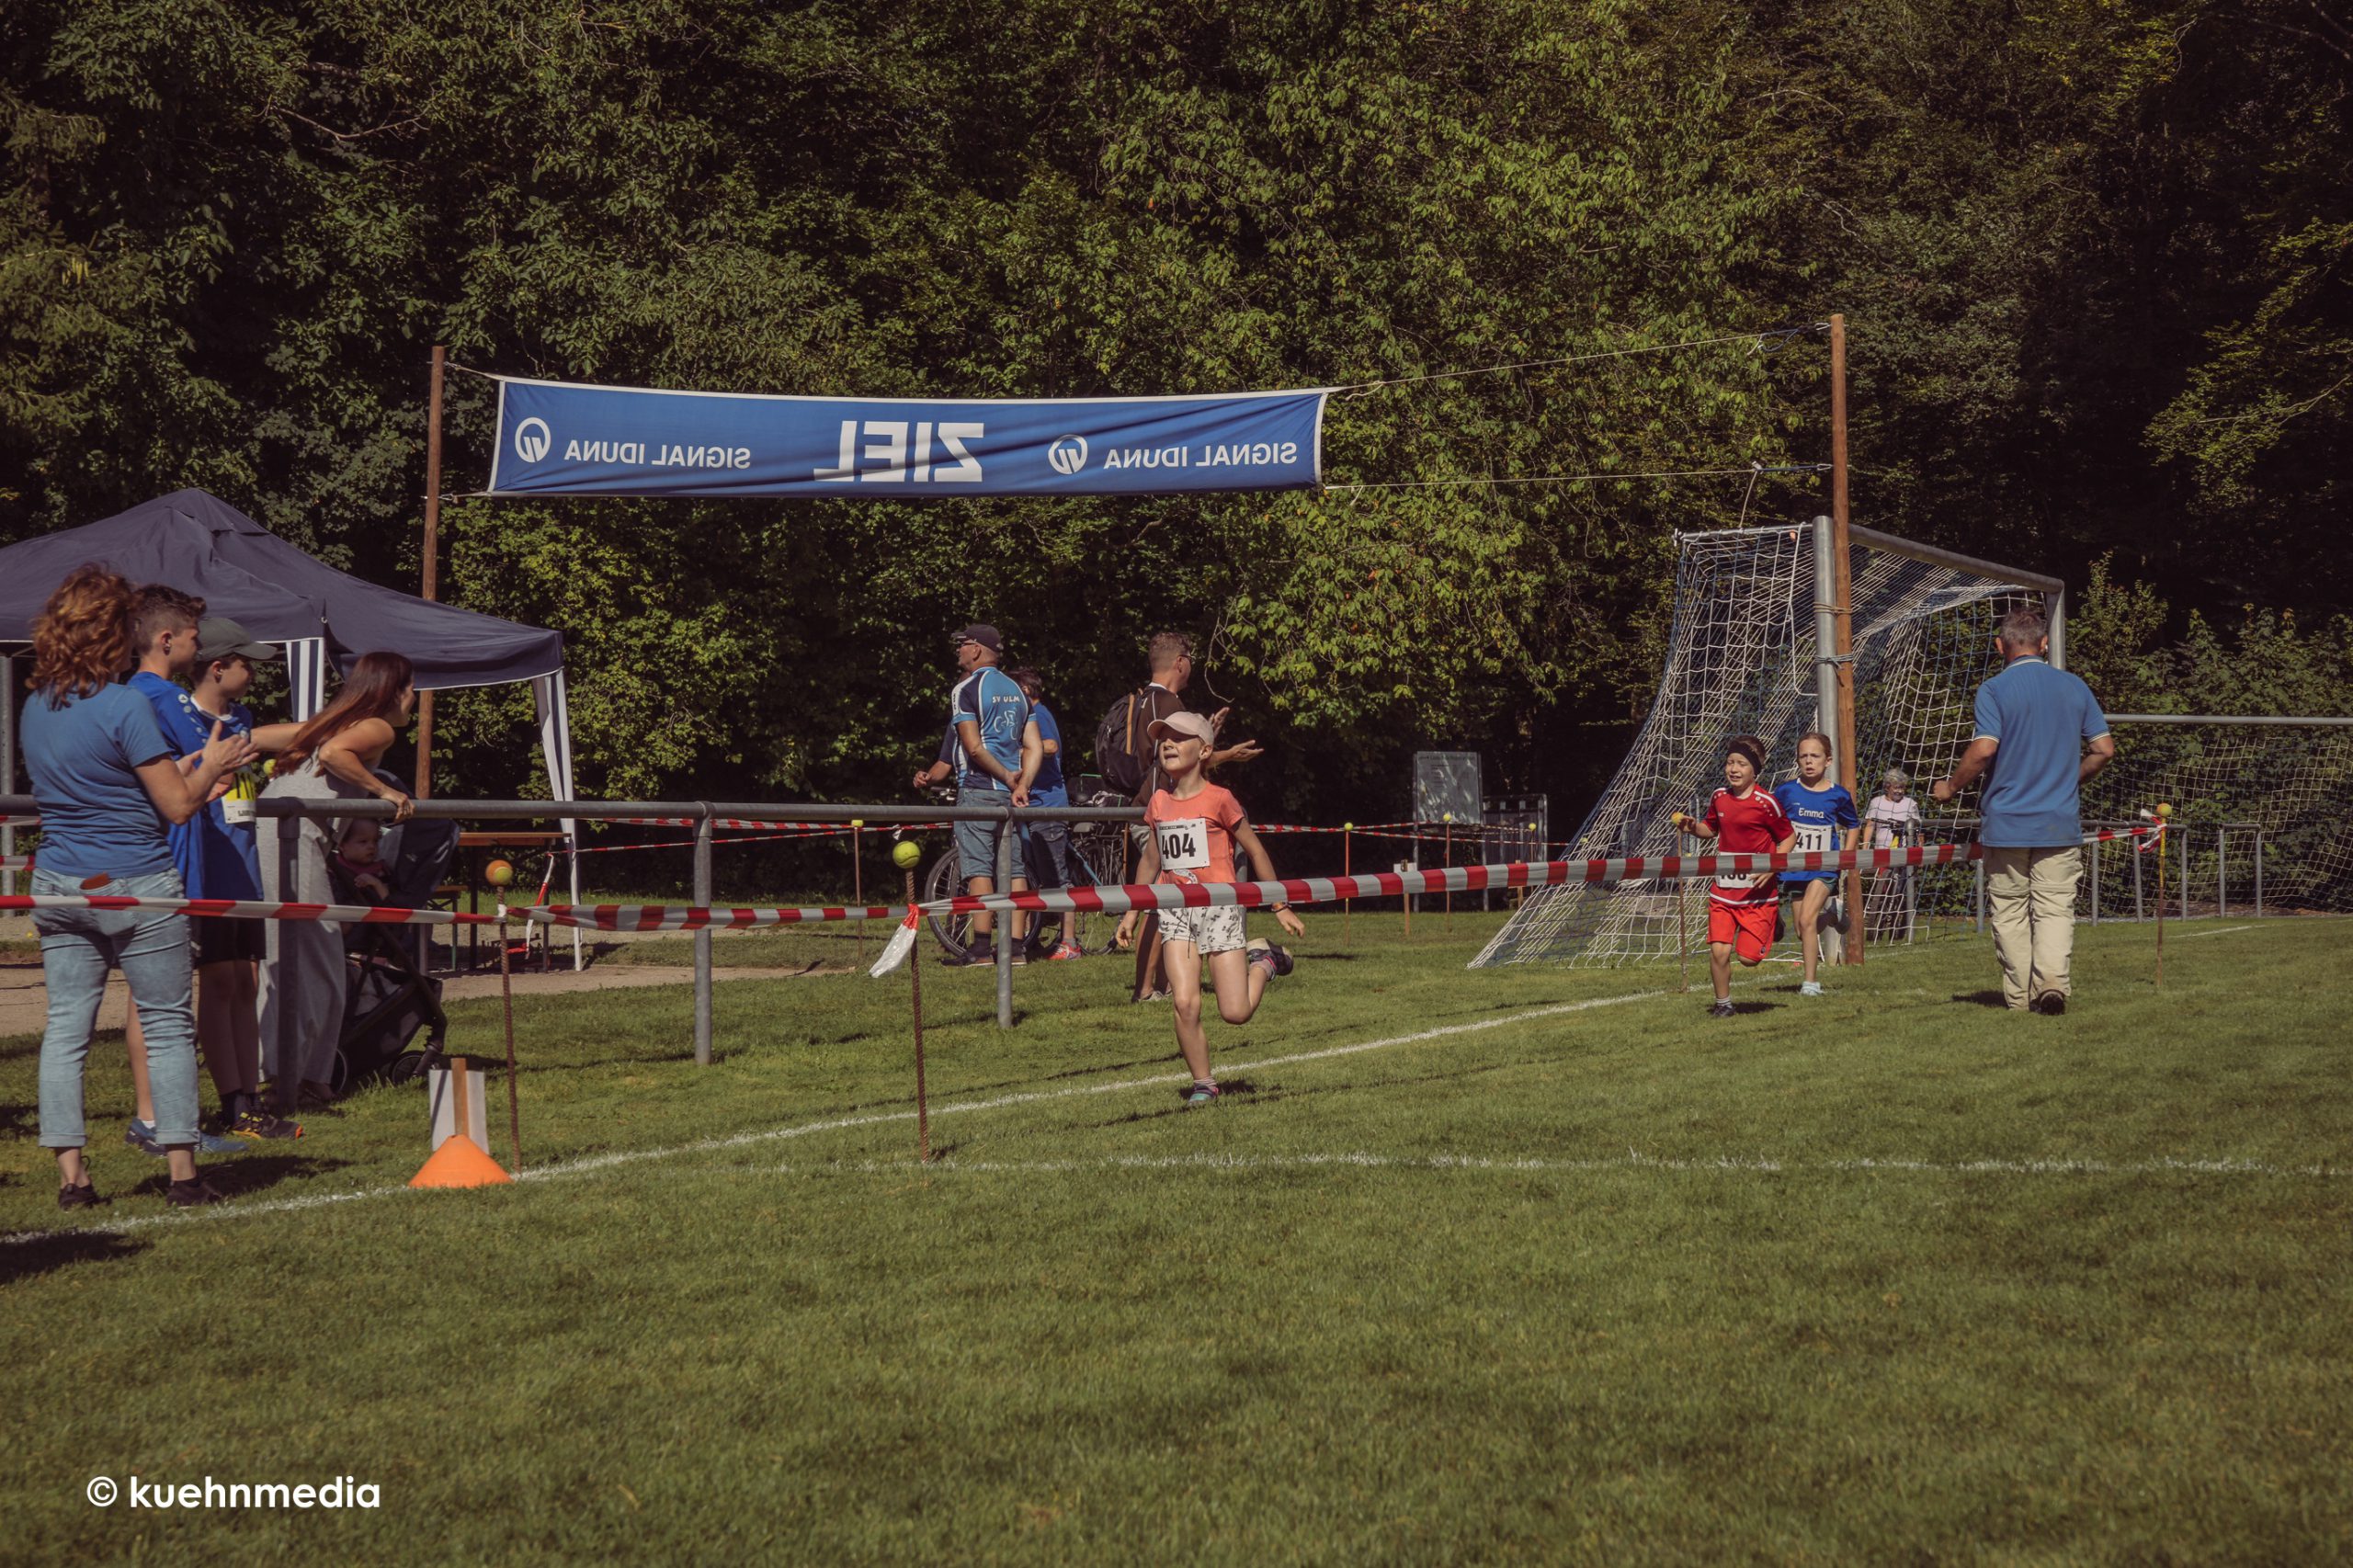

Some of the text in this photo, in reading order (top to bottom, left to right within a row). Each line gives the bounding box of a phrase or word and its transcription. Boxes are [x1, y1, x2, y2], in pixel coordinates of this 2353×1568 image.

[1003, 696, 1020, 704] ULM
[1798, 807, 1824, 819] Emma
[1161, 833, 1197, 859] 404
[1795, 831, 1823, 851] 411
